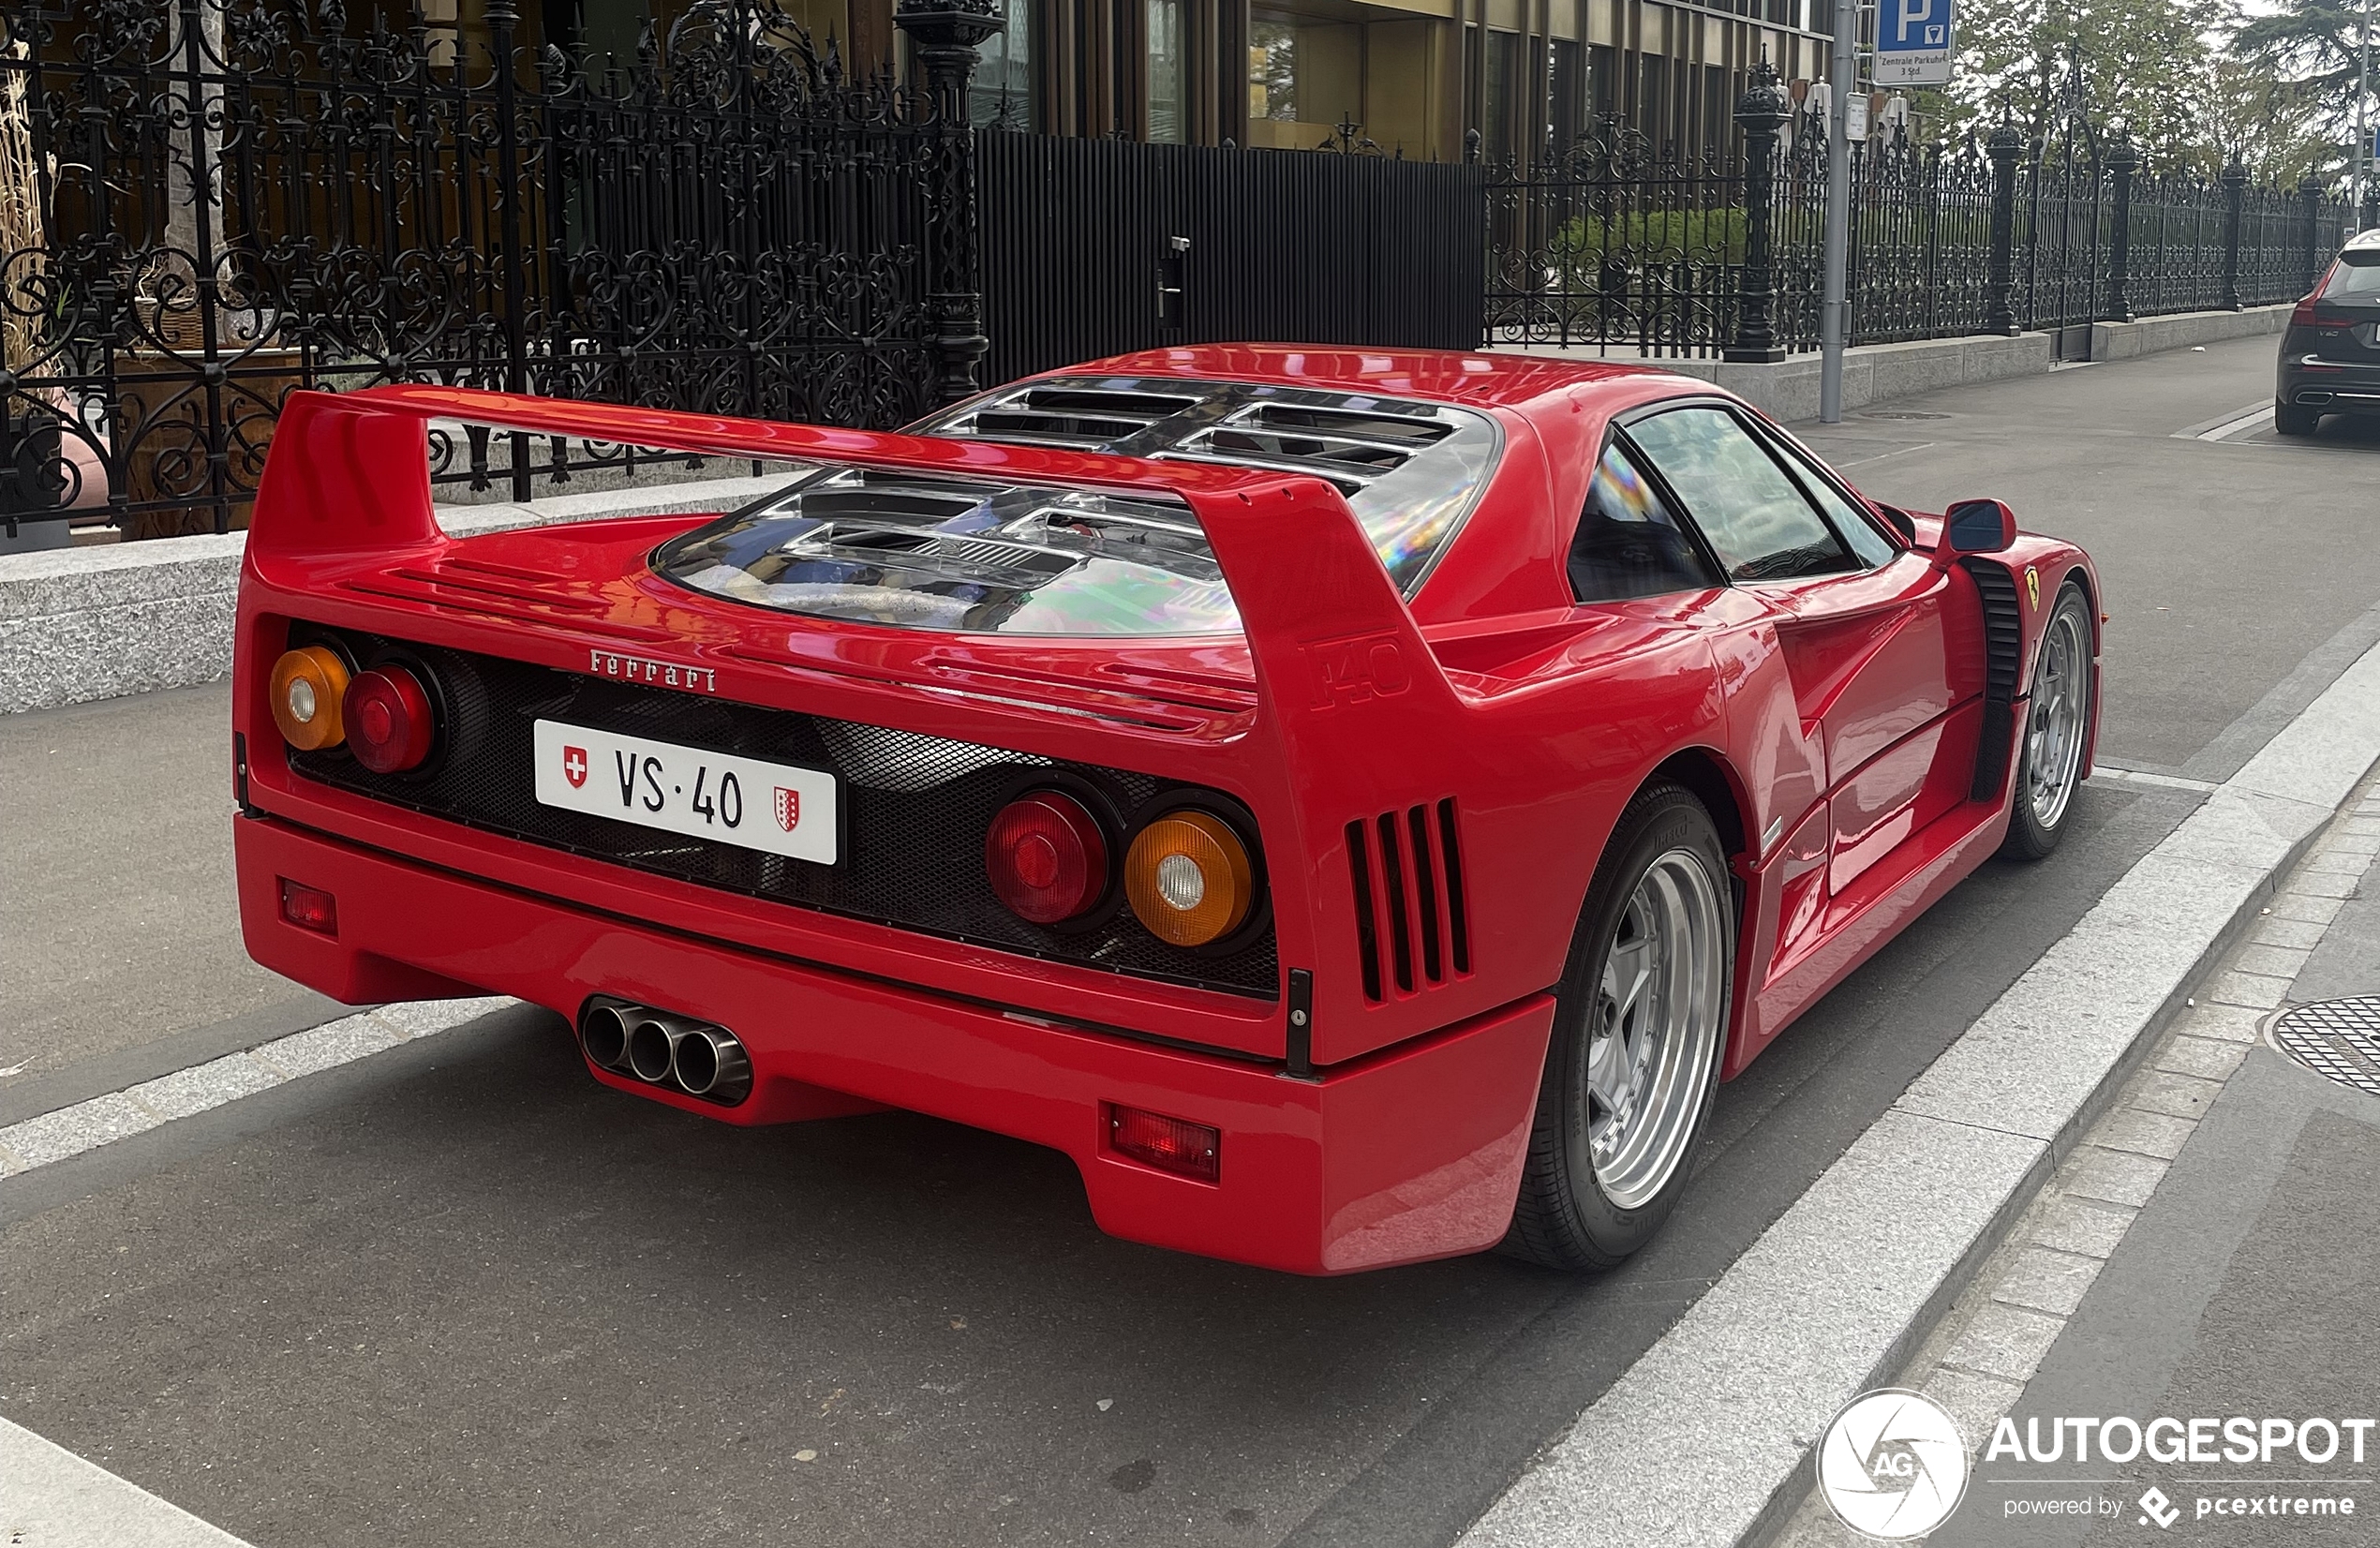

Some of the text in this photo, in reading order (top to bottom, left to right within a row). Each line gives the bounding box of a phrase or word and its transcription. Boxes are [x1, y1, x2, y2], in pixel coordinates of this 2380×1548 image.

[1897, 0, 1931, 42] P
[1882, 57, 1912, 67] Zentrale
[1901, 67, 1907, 76] 3
[590, 648, 715, 692] Ferrari
